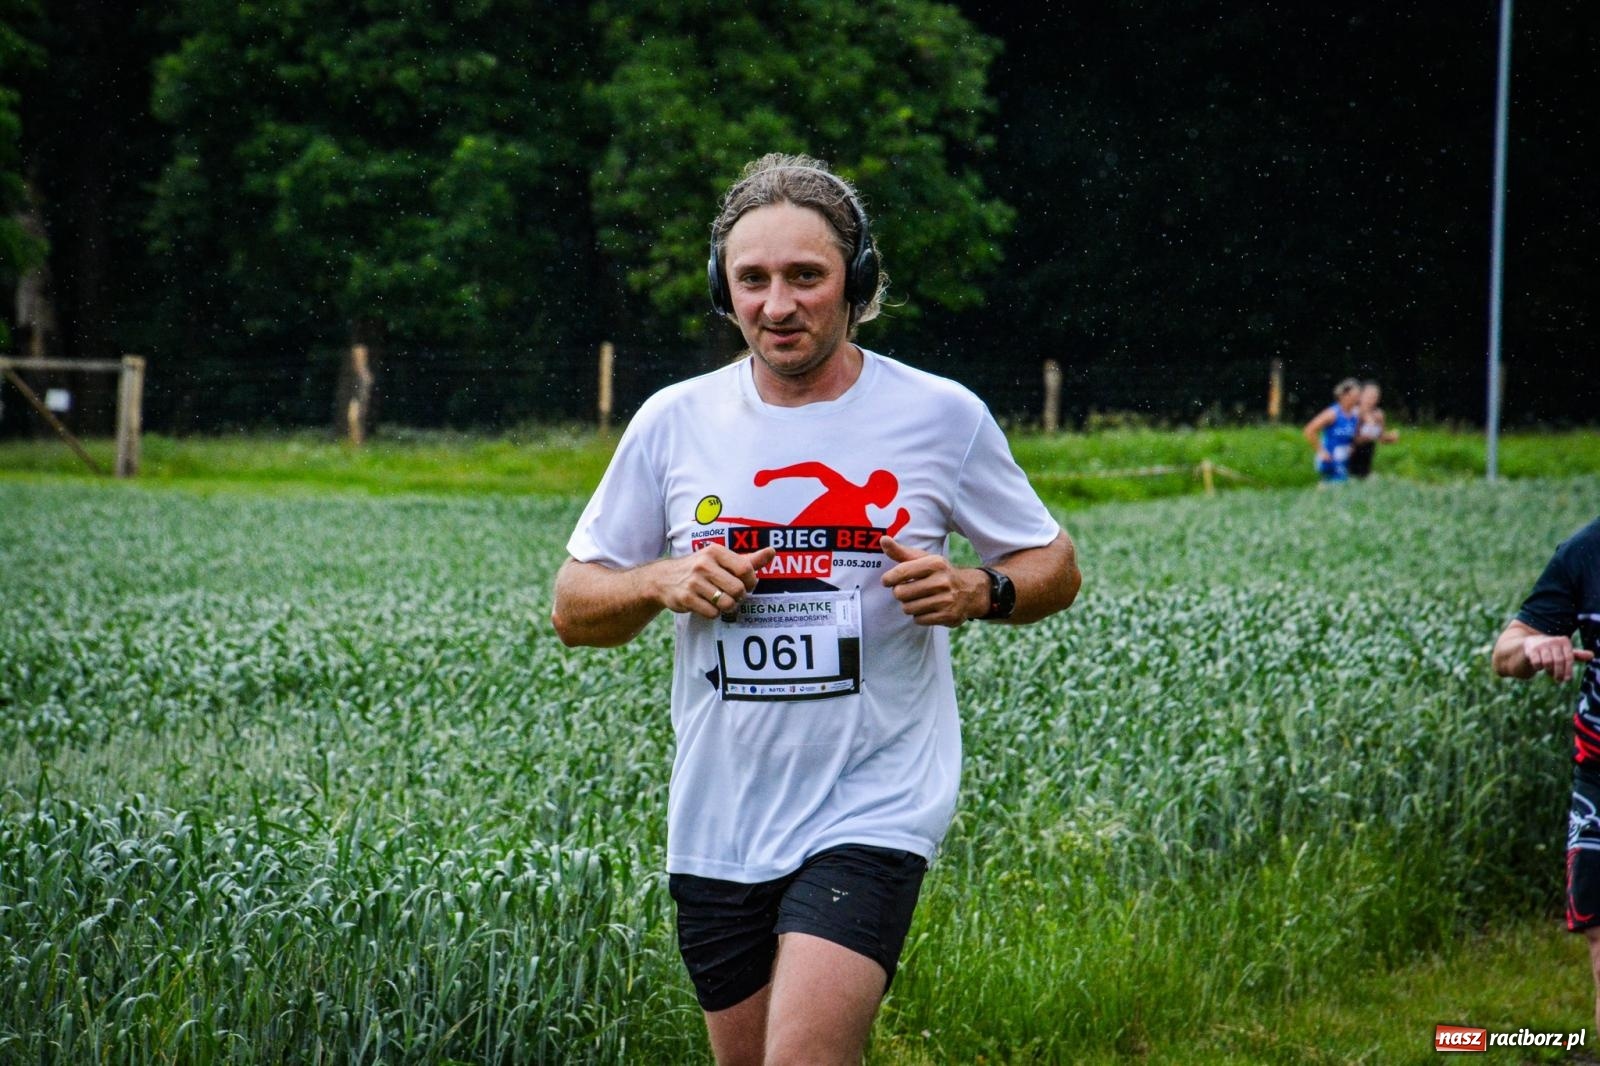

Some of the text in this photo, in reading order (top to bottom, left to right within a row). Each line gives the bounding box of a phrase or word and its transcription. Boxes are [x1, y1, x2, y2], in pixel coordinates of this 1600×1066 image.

[733, 529, 882, 549] XI BIEG BEZ
[833, 559, 882, 568] 03.05.2018
[741, 604, 765, 614] BIEG
[767, 603, 785, 613] NA
[789, 602, 832, 614] PIĄTKĘ
[743, 634, 814, 671] 061
